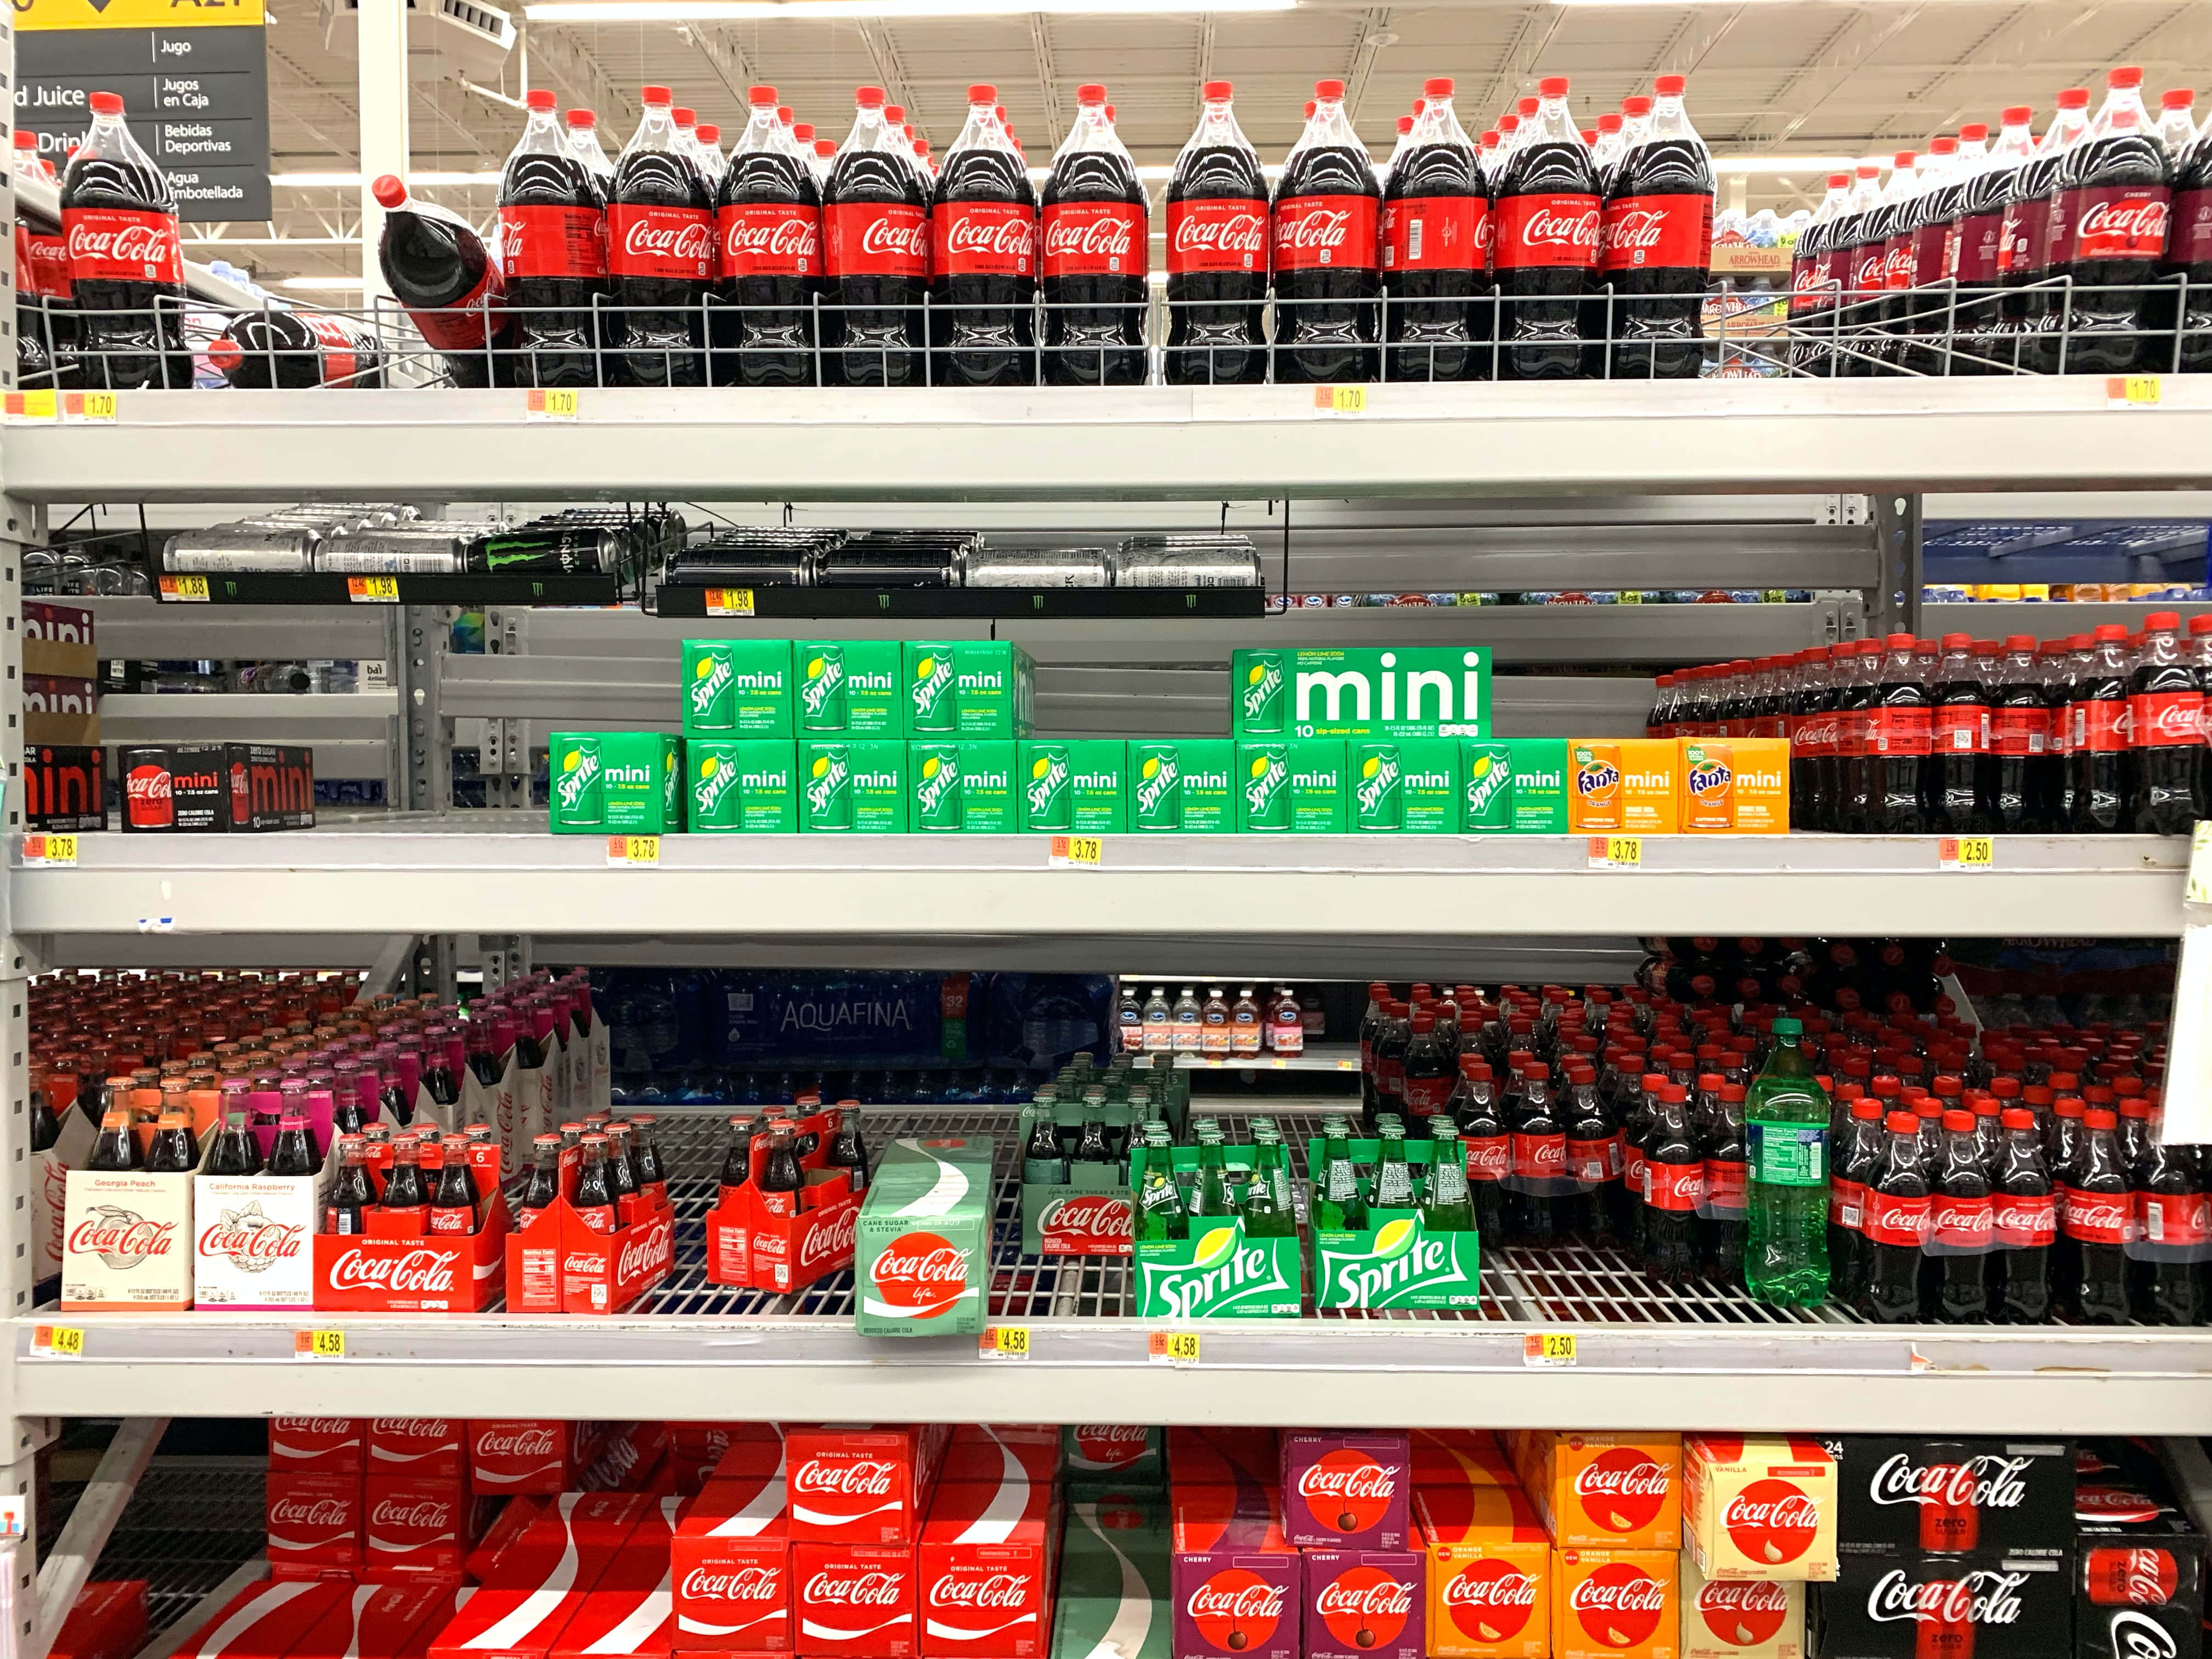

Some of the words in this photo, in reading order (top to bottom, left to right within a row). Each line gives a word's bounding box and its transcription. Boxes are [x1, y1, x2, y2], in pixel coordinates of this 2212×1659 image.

[161, 40, 191, 54] Jugo
[33, 86, 84, 106] Juice
[163, 78, 199, 92] Jugos
[163, 97, 180, 105] en
[182, 94, 208, 108] Caja
[38, 133, 86, 153] Drin
[165, 125, 212, 137] Bebidas
[165, 140, 231, 154] Deportivas
[167, 172, 199, 184] Agua
[947, 217, 1032, 255] Coca-Cola
[1176, 215, 1265, 252] Coca-Cola
[2078, 202, 2169, 238] Coca-Cola
[69, 223, 166, 263] Coca-Cola
[625, 219, 712, 258] Coca-Cola
[728, 219, 817, 256] Coca-Cola
[1046, 218, 1133, 255] Coca-Cola
[1729, 255, 1780, 265] ARROWHEAD
[692, 661, 732, 713] Sprite
[738, 672, 781, 688] mini
[803, 661, 843, 713] Sprite
[849, 672, 891, 688] mini
[913, 661, 953, 713] Sprite
[958, 671, 1001, 688] mini
[1245, 669, 1283, 718] Sprite
[1296, 652, 1479, 720] mini
[1295, 725, 1313, 737] 10
[174, 772, 217, 787] mini
[251, 752, 311, 812] mini
[557, 755, 600, 807] Sprite
[605, 765, 649, 782] mini
[696, 760, 737, 814] Sprite
[743, 771, 786, 787] mini
[807, 760, 848, 813] Sprite
[855, 771, 896, 787] mini
[1028, 760, 1068, 814] Sprite
[1074, 772, 1116, 787] mini
[1246, 761, 1286, 812] Sprite
[1293, 771, 1336, 786] mini
[1357, 761, 1399, 812] Sprite
[1405, 771, 1449, 787] mini
[1468, 759, 1510, 814] Sprite
[1516, 770, 1560, 787] mini
[1577, 767, 1618, 793] Fanta
[1626, 770, 1669, 787] mini
[1689, 767, 1731, 794] Fanta
[1737, 770, 1781, 787] mini
[253, 817, 260, 828] 10
[781, 1000, 912, 1031] AQUAFINA
[946, 995, 962, 1007] 32
[476, 1152, 485, 1163] 6
[95, 1180, 127, 1188] Georgia
[252, 1183, 295, 1192] Raspberry
[1144, 1183, 1173, 1205] Sprite
[68, 1220, 179, 1255] Coca-Cola
[199, 1223, 306, 1257] Coca-Cola
[801, 1206, 859, 1266] Coca-Col
[565, 1256, 607, 1274] Coca-Cola
[617, 1220, 670, 1287] Coca-Cola
[870, 1248, 975, 1283] Coca-Cola
[1336, 1231, 1445, 1308] Sprite
[330, 1249, 460, 1291] Coca-Cola
[1158, 1239, 1266, 1317] Sprite
[476, 1430, 557, 1457] Coca-Cola
[1825, 1441, 1843, 1453] 24
[795, 1460, 897, 1495] Coca-Cola
[1298, 1465, 1400, 1498] Coca-Cola
[1575, 1463, 1675, 1496] Coca-Cola
[1870, 1453, 2036, 1508] Coca-Cola
[270, 1499, 352, 1526] Coca-Cola
[1720, 1494, 1826, 1528] Coca-Cola
[1935, 1518, 1966, 1528] zero
[681, 1567, 782, 1600] Coca-Cola
[803, 1572, 905, 1606] Coca-Cola
[929, 1575, 1031, 1607] Coca-Cola
[1317, 1583, 1418, 1615] Coca-Cola
[1442, 1573, 1541, 1606] Coca-Cola
[1570, 1578, 1670, 1611] Coca-Cola
[1867, 1569, 2032, 1623] Coca-Cola
[1187, 1584, 1289, 1617] Coca-Cola
[1932, 1633, 1963, 1643] zero
